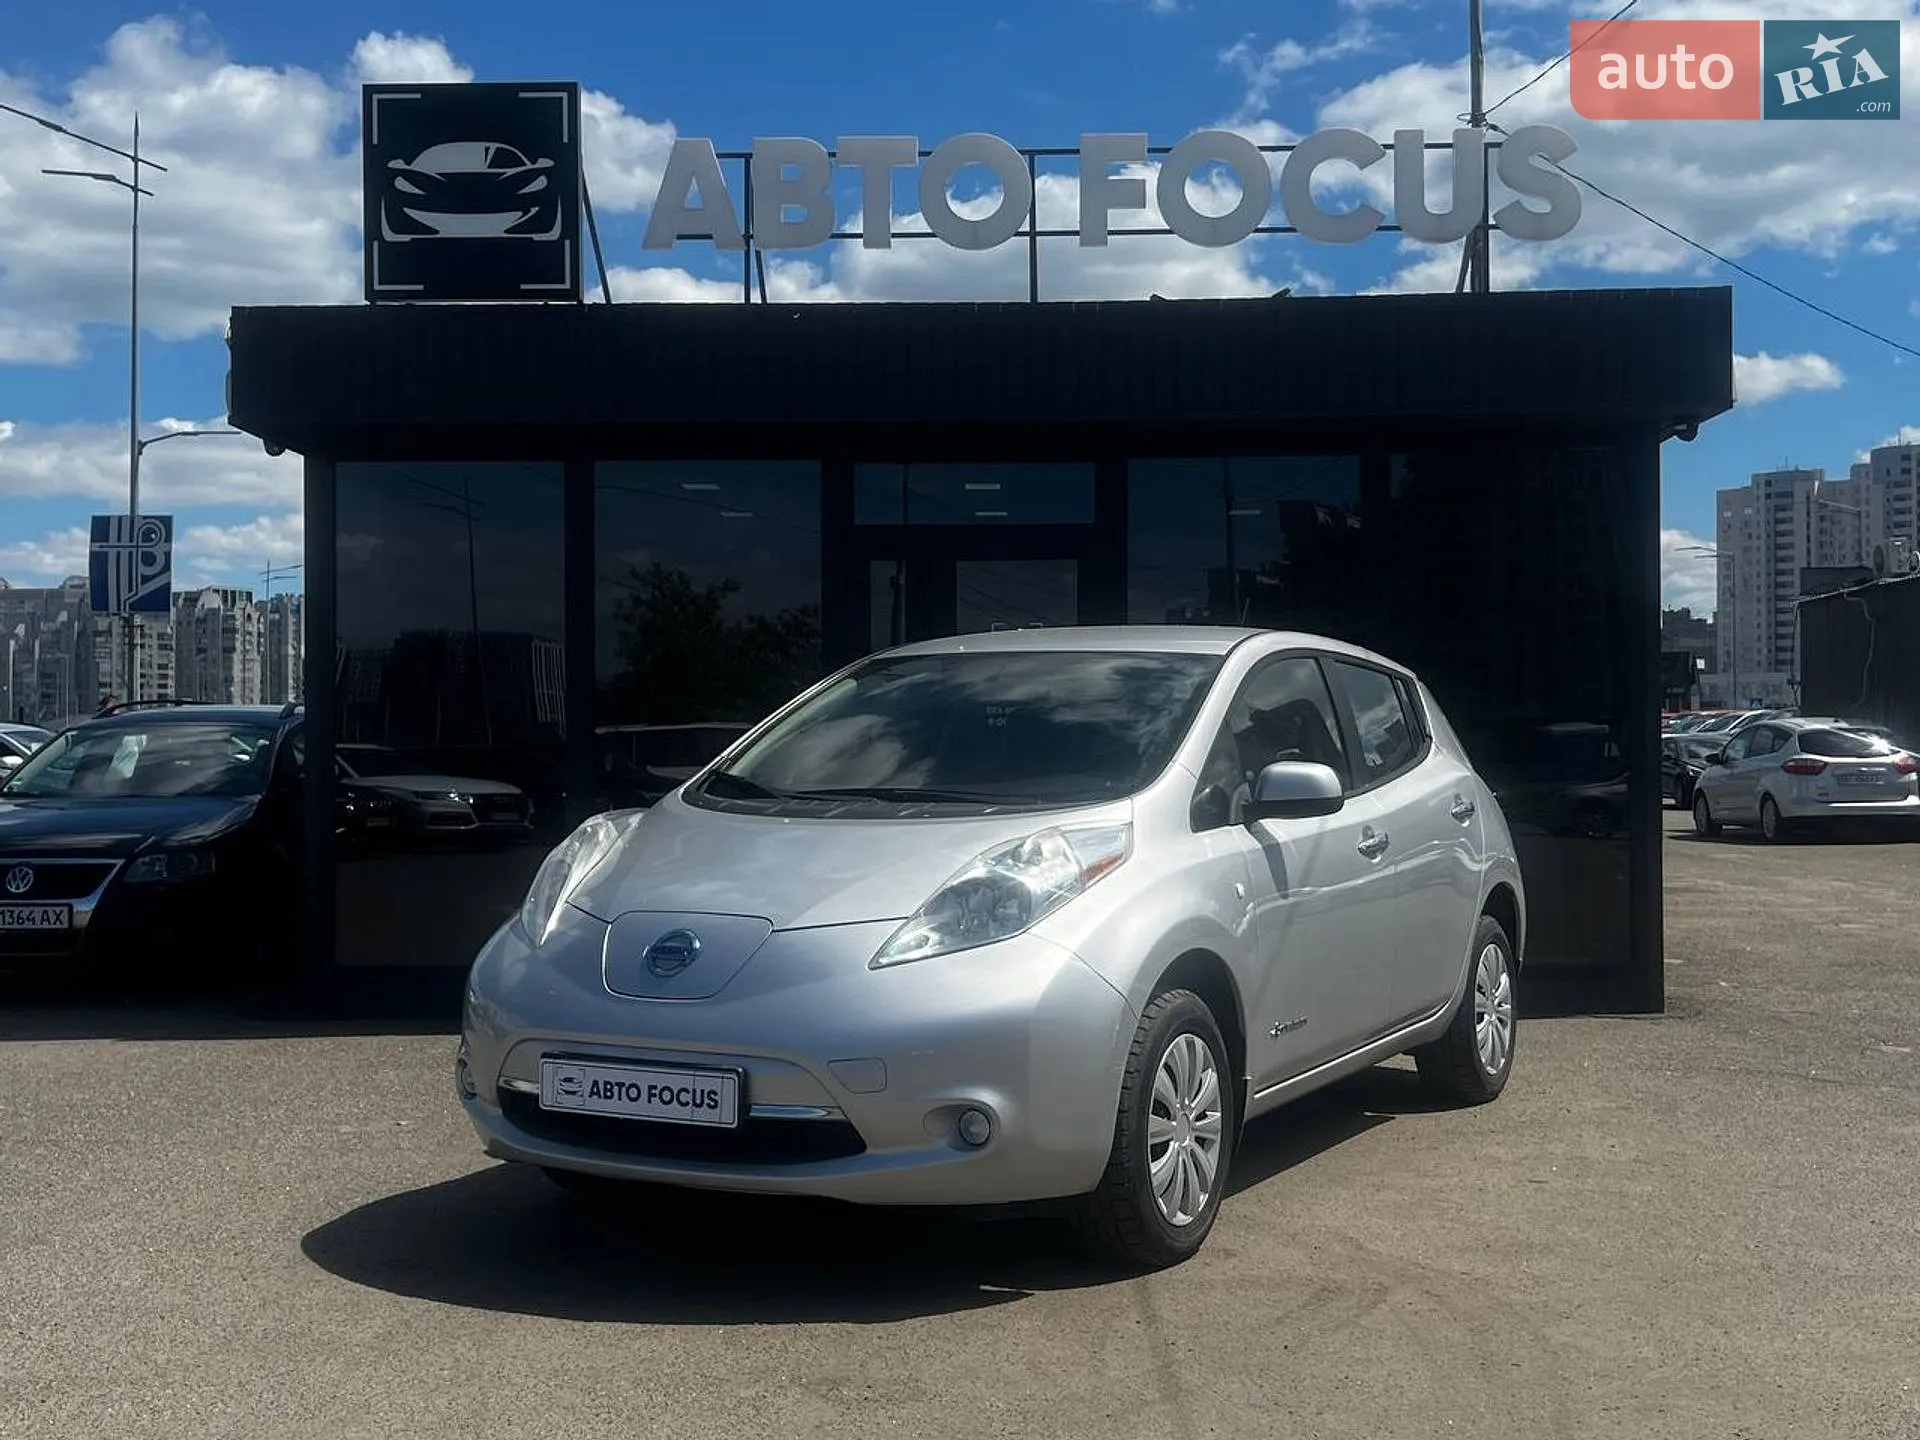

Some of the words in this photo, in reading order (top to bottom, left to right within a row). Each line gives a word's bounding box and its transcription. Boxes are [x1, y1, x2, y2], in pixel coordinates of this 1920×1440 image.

[642, 132, 1032, 251] АВТО
[1079, 124, 1582, 248] FOCUS
[588, 1079, 642, 1103] АВТО
[647, 1084, 720, 1110] FOCUS
